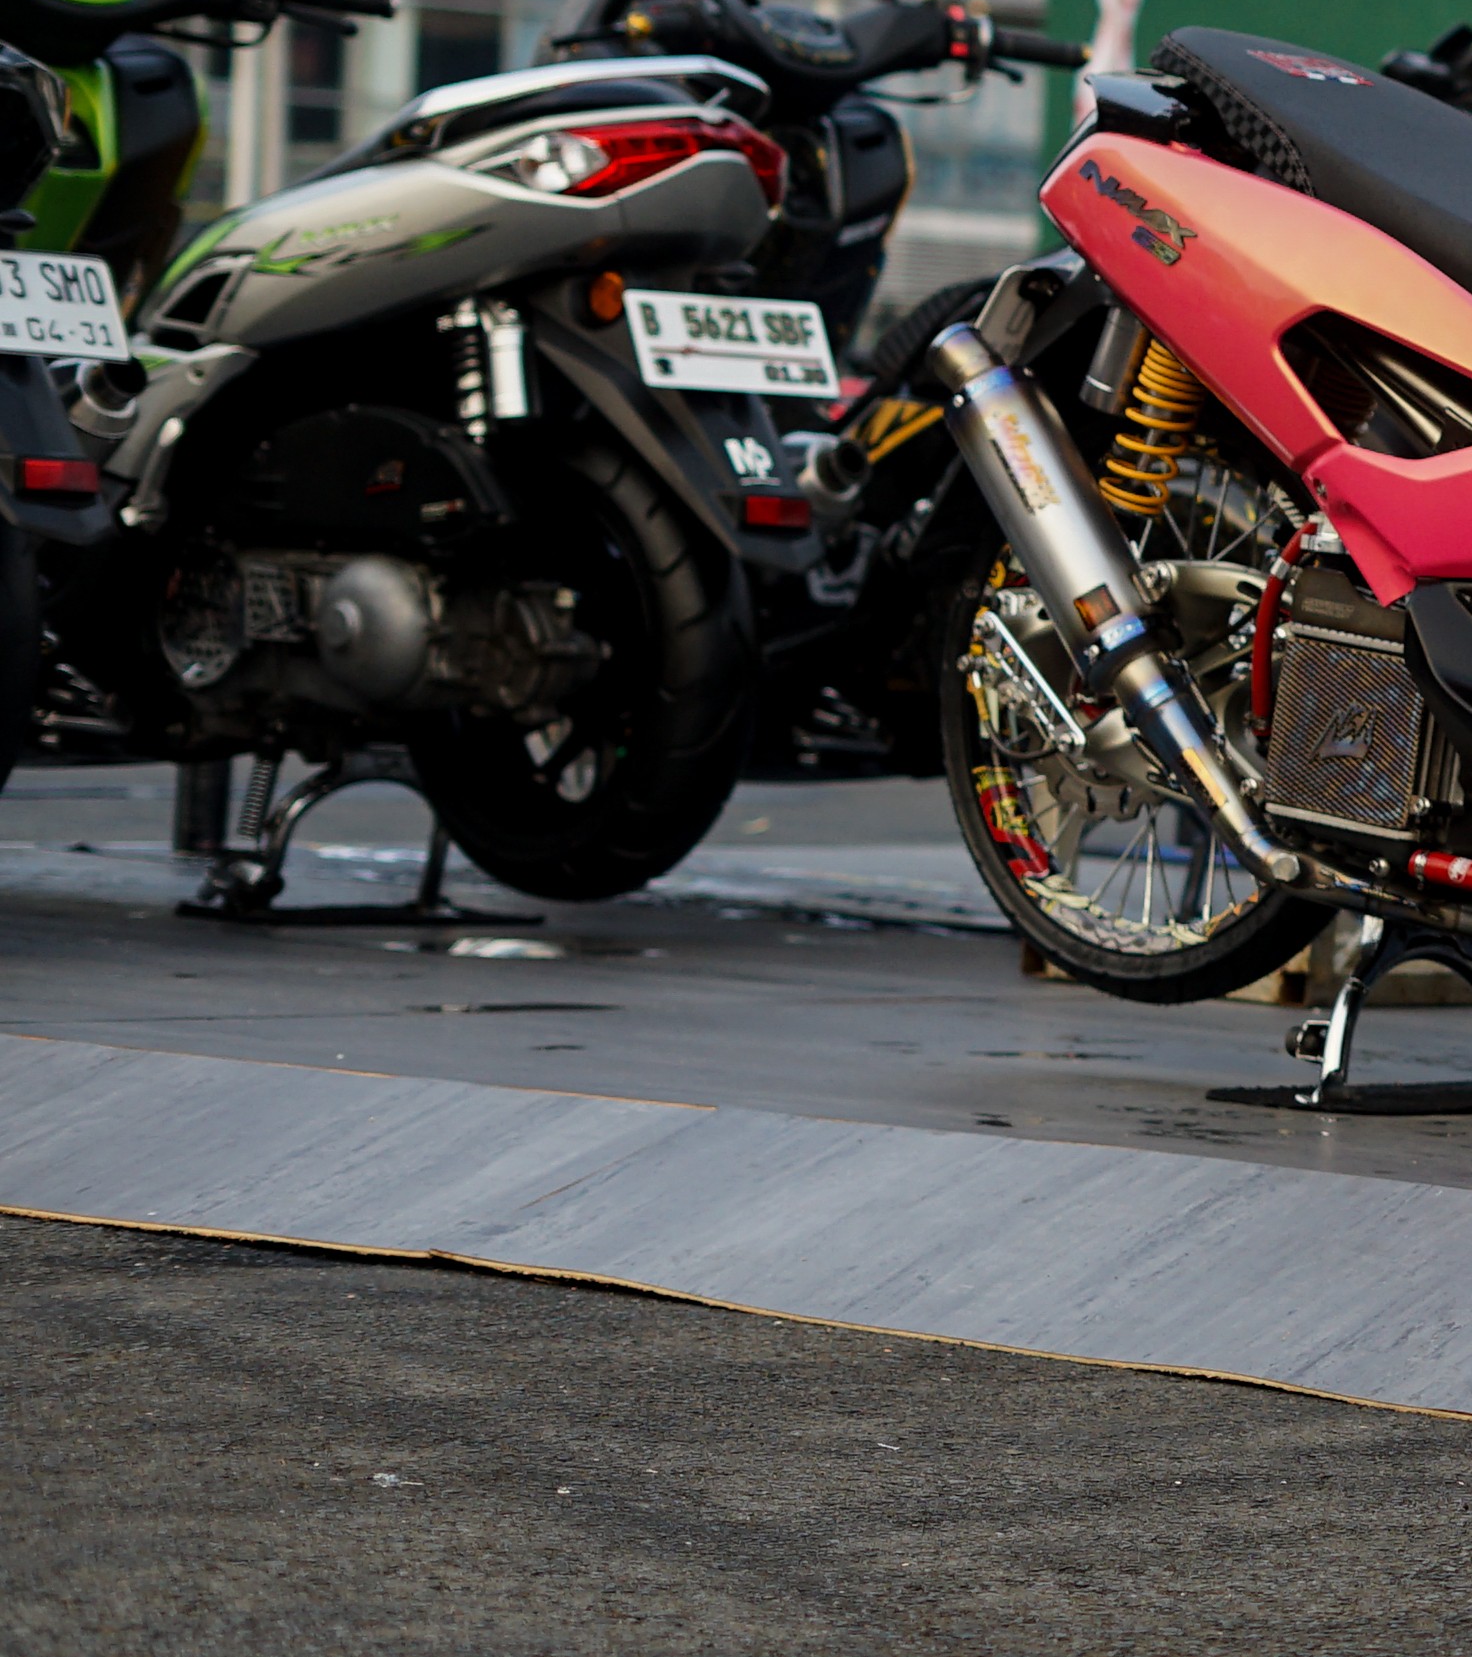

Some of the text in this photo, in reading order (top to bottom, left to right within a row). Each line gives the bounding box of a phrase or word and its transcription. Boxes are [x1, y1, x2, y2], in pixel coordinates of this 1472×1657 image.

[1079, 159, 1199, 249] NMAX
[0, 257, 106, 307] 3 SMO
[639, 301, 815, 347] B 5621 SBF
